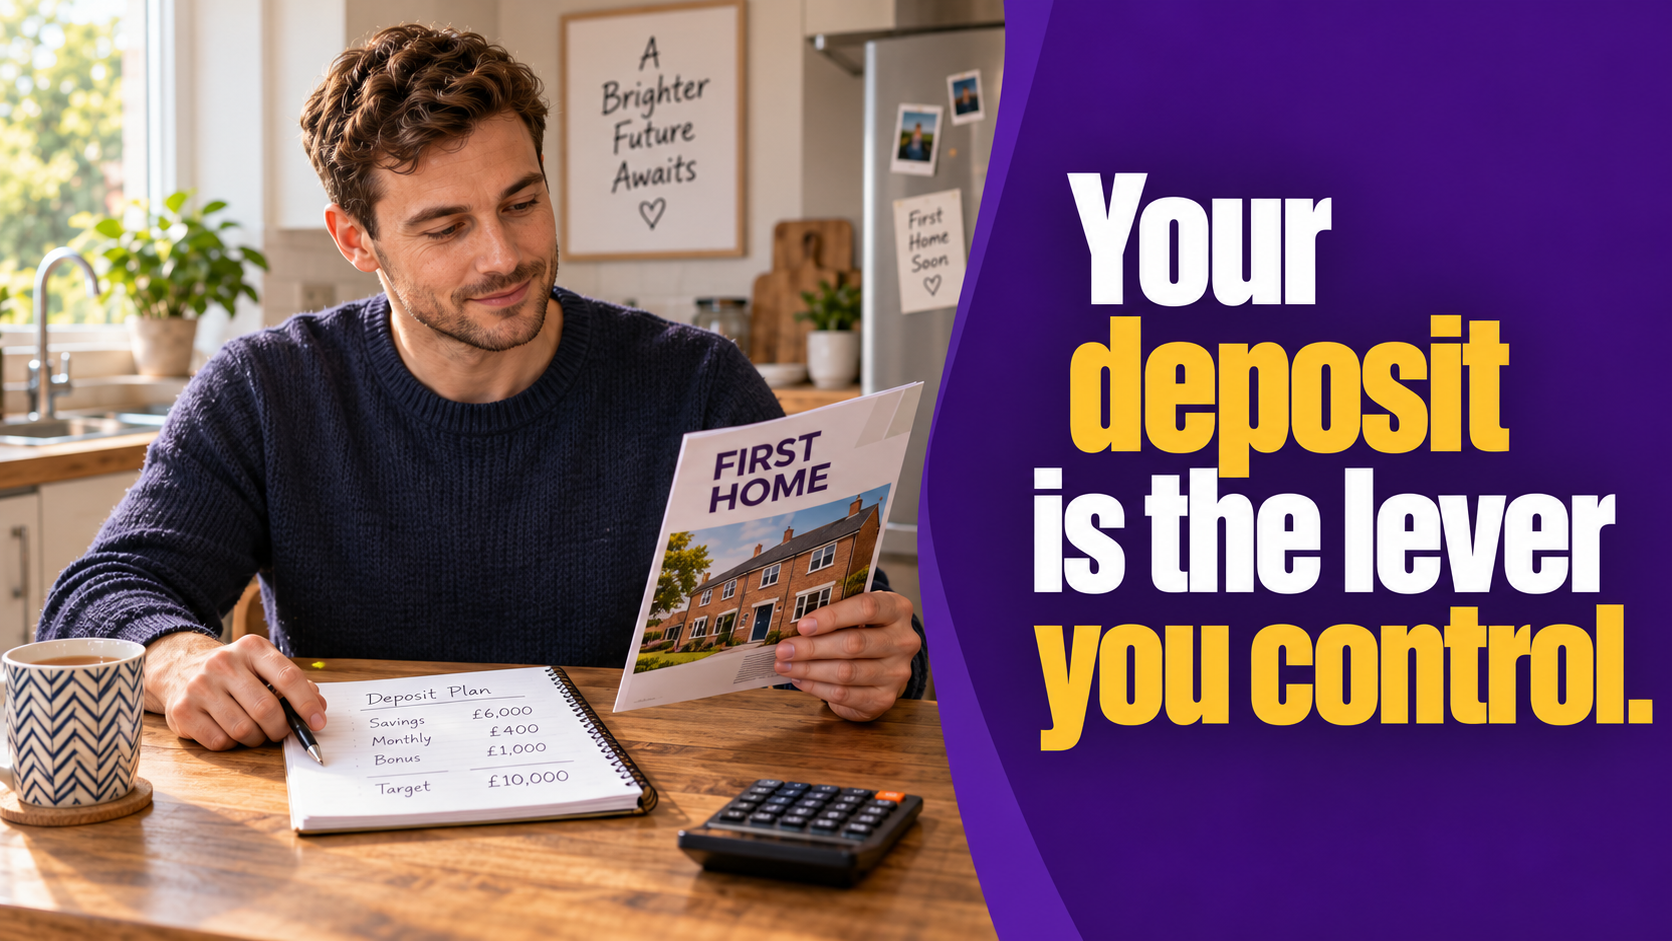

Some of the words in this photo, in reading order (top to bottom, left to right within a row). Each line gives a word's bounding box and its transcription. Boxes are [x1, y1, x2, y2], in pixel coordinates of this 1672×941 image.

[639, 35, 660, 71] A
[601, 73, 711, 119] Brighter
[612, 119, 695, 154] Future
[611, 155, 697, 193] Awaits
[908, 207, 943, 229] First
[909, 231, 949, 252] Home
[911, 255, 949, 273] Soon
[713, 430, 822, 480] FIRST
[709, 462, 831, 513] HOME
[366, 688, 437, 707] Deposit
[448, 685, 491, 698] Plan
[369, 715, 425, 730] Savings
[472, 705, 533, 720] £6,000
[372, 733, 432, 747] Monthly
[490, 723, 539, 737] £400
[375, 753, 421, 766] Bonus
[487, 742, 546, 757] £1,000
[376, 780, 431, 798] Target
[488, 770, 569, 788] £10,000
